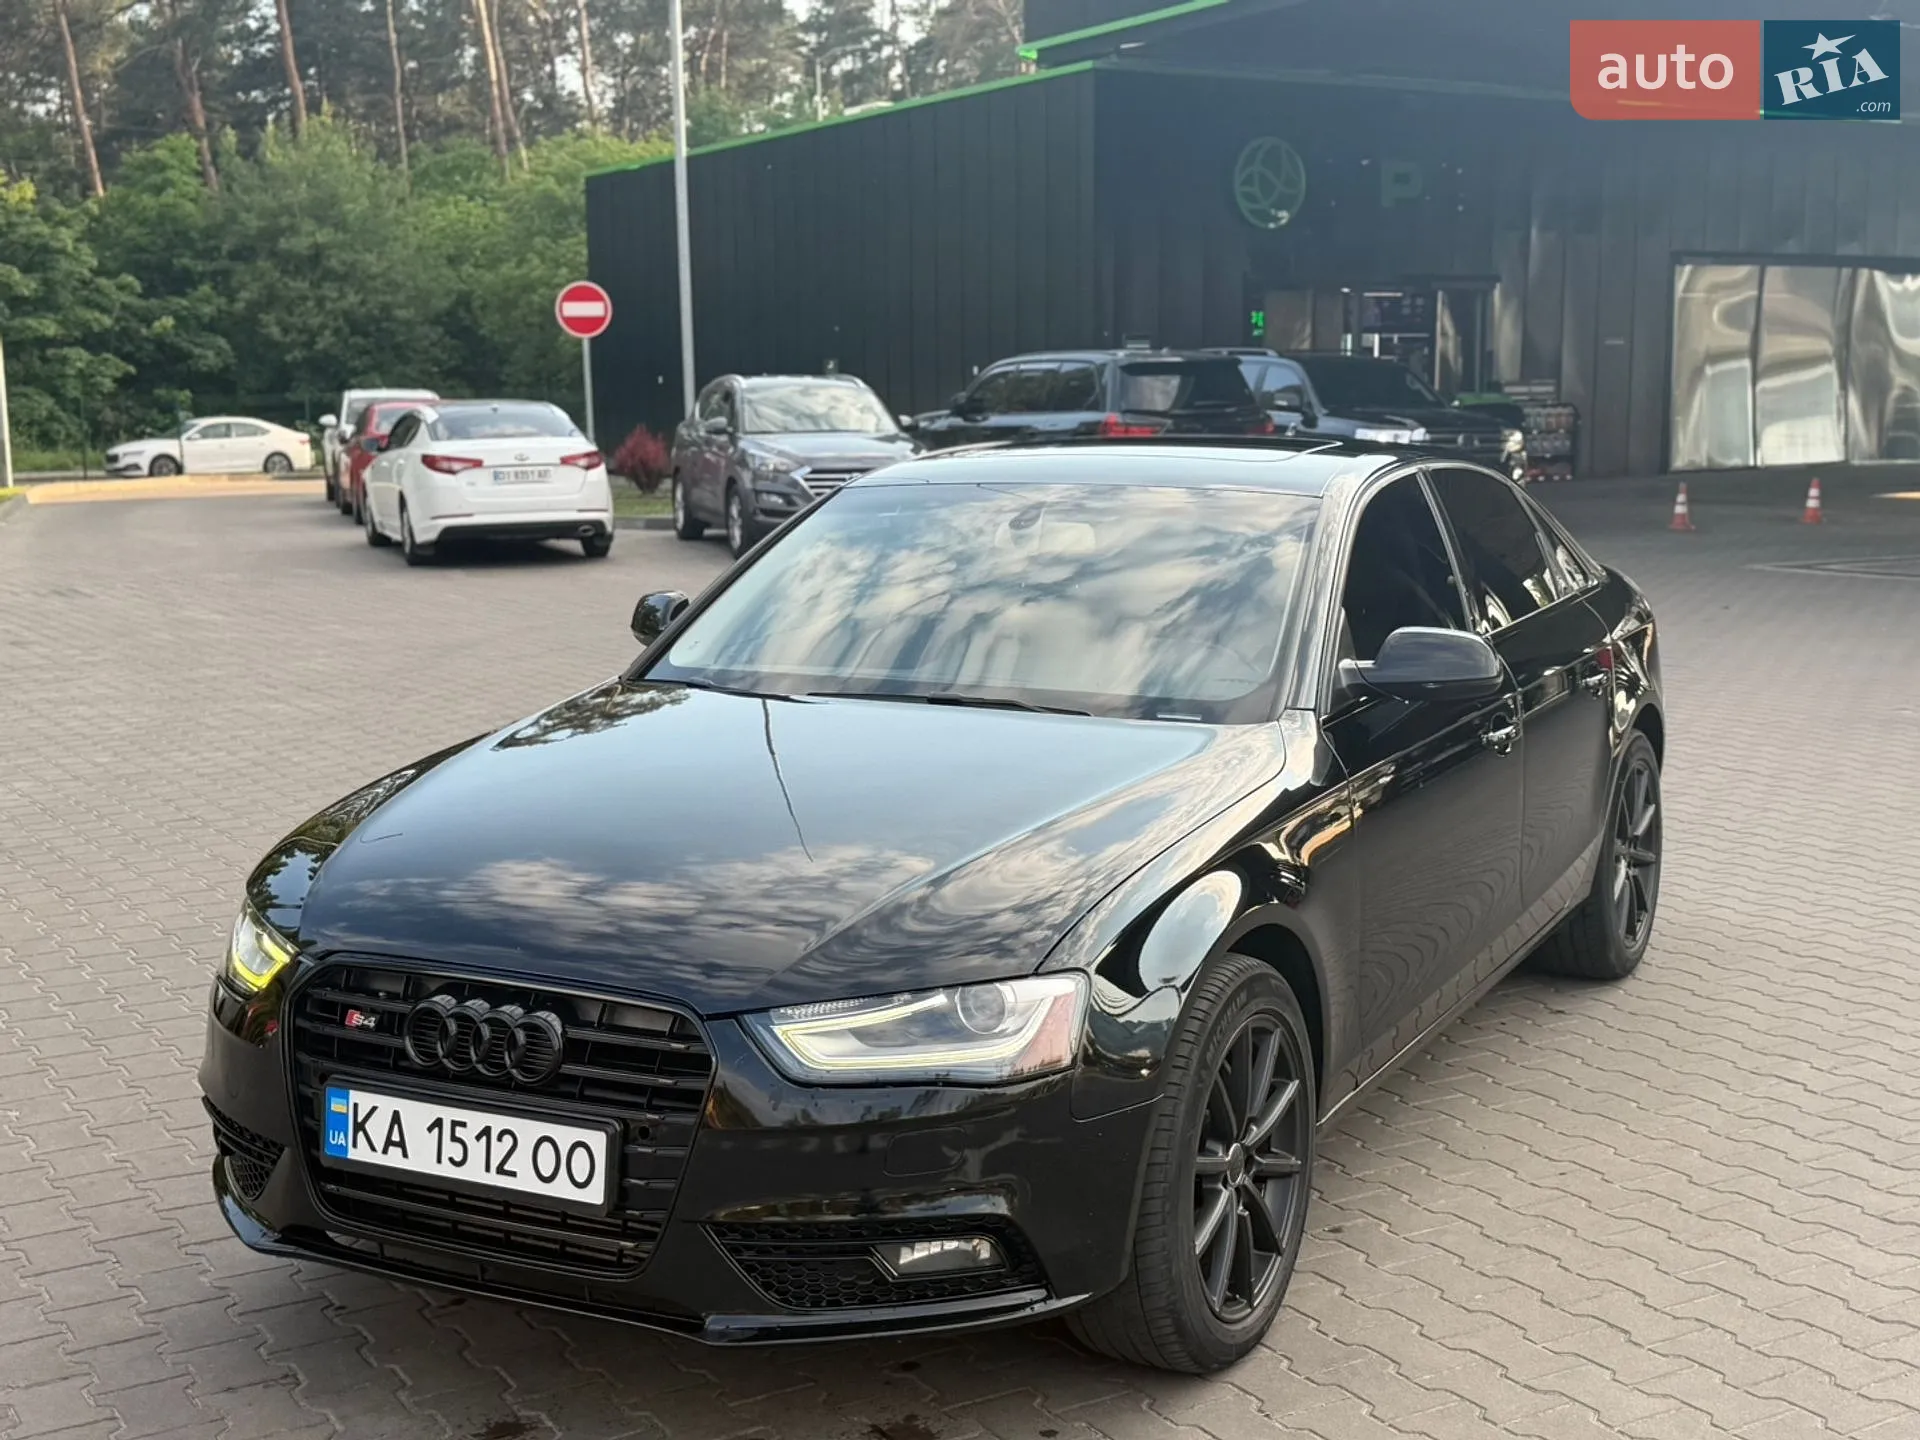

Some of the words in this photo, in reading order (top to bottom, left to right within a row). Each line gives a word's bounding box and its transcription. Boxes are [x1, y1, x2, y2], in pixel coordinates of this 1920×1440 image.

[351, 1012, 376, 1028] S4
[329, 1129, 346, 1147] UA
[351, 1101, 409, 1160] KA
[426, 1116, 519, 1178] 1512
